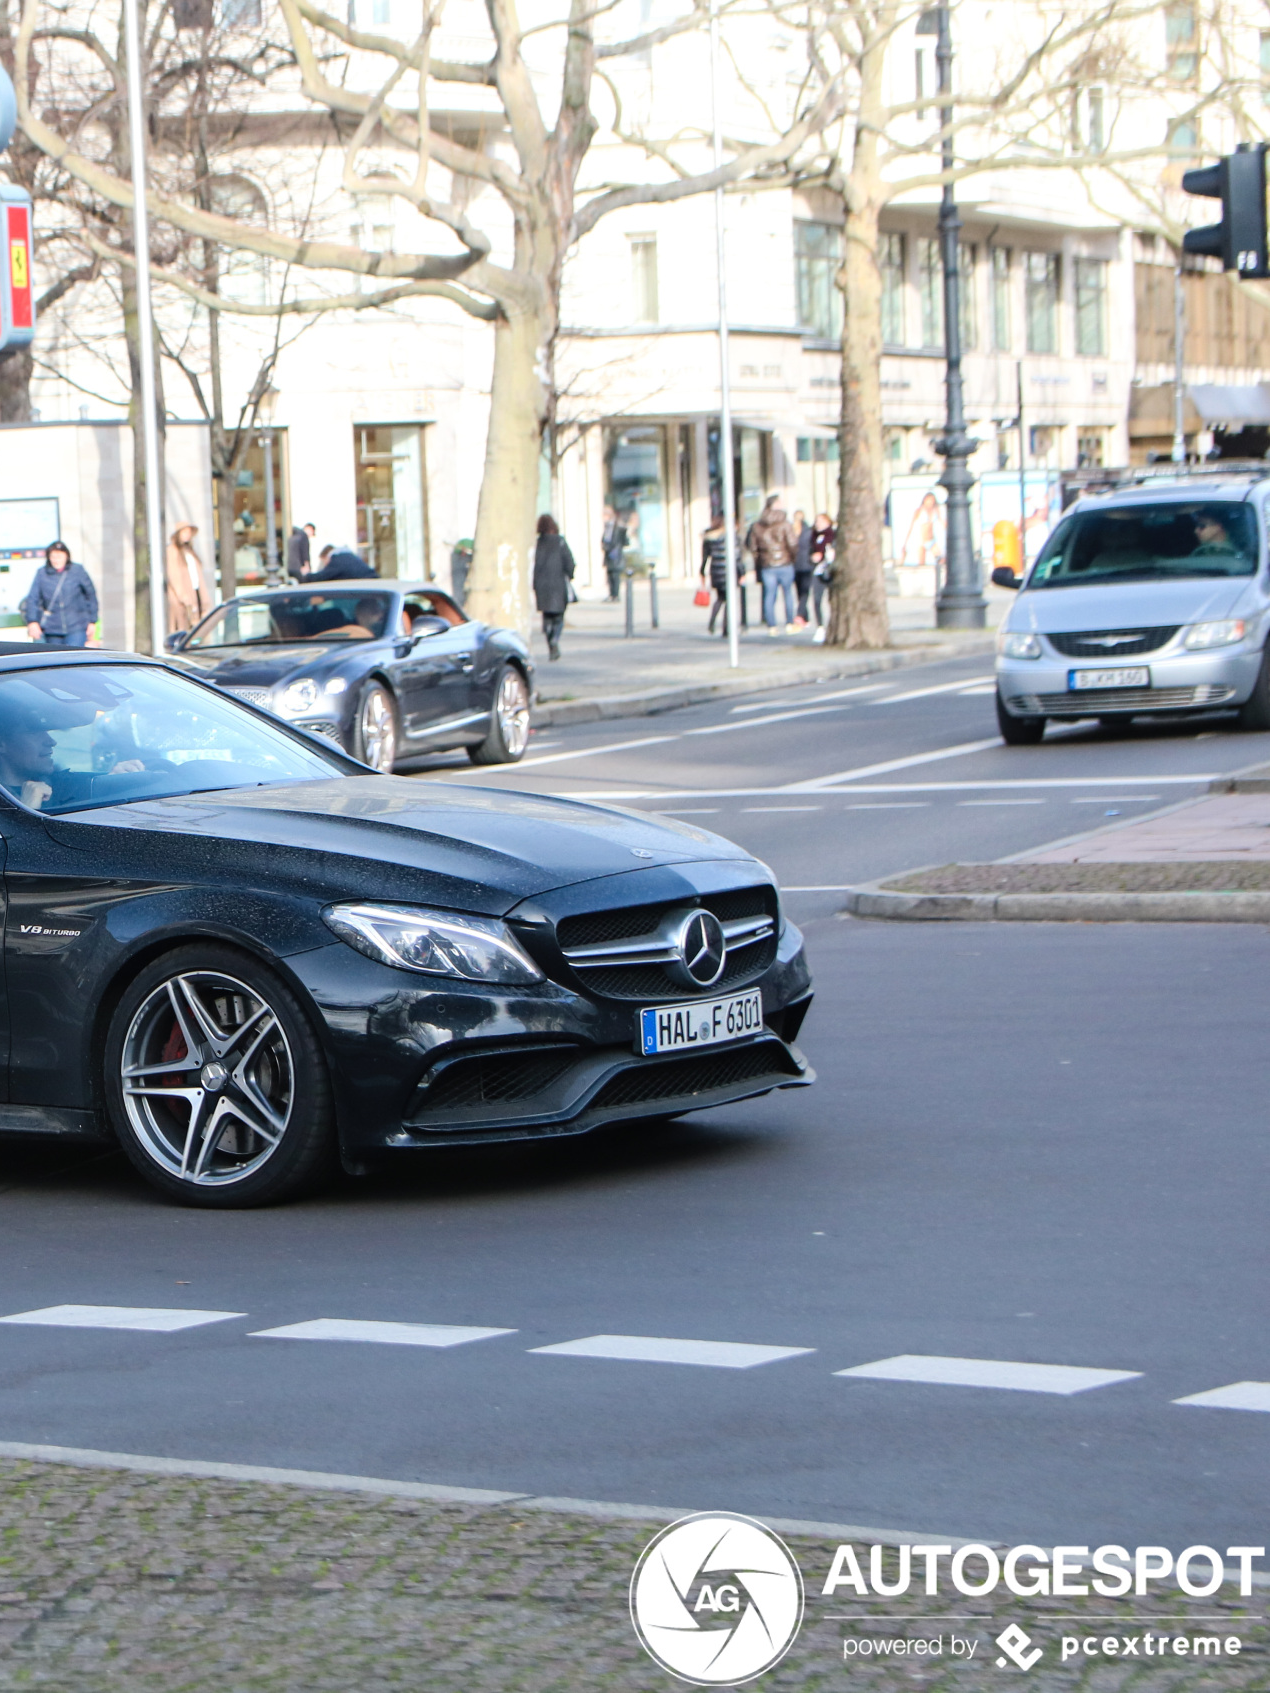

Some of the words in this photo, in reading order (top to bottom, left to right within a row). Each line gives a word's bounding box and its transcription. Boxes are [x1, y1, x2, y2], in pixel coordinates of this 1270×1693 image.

[20, 924, 42, 934] V8
[42, 928, 81, 937] BITURBO
[659, 1011, 697, 1046] HAL
[712, 1005, 722, 1037] F
[726, 996, 760, 1034] 6301
[647, 1036, 653, 1046] D
